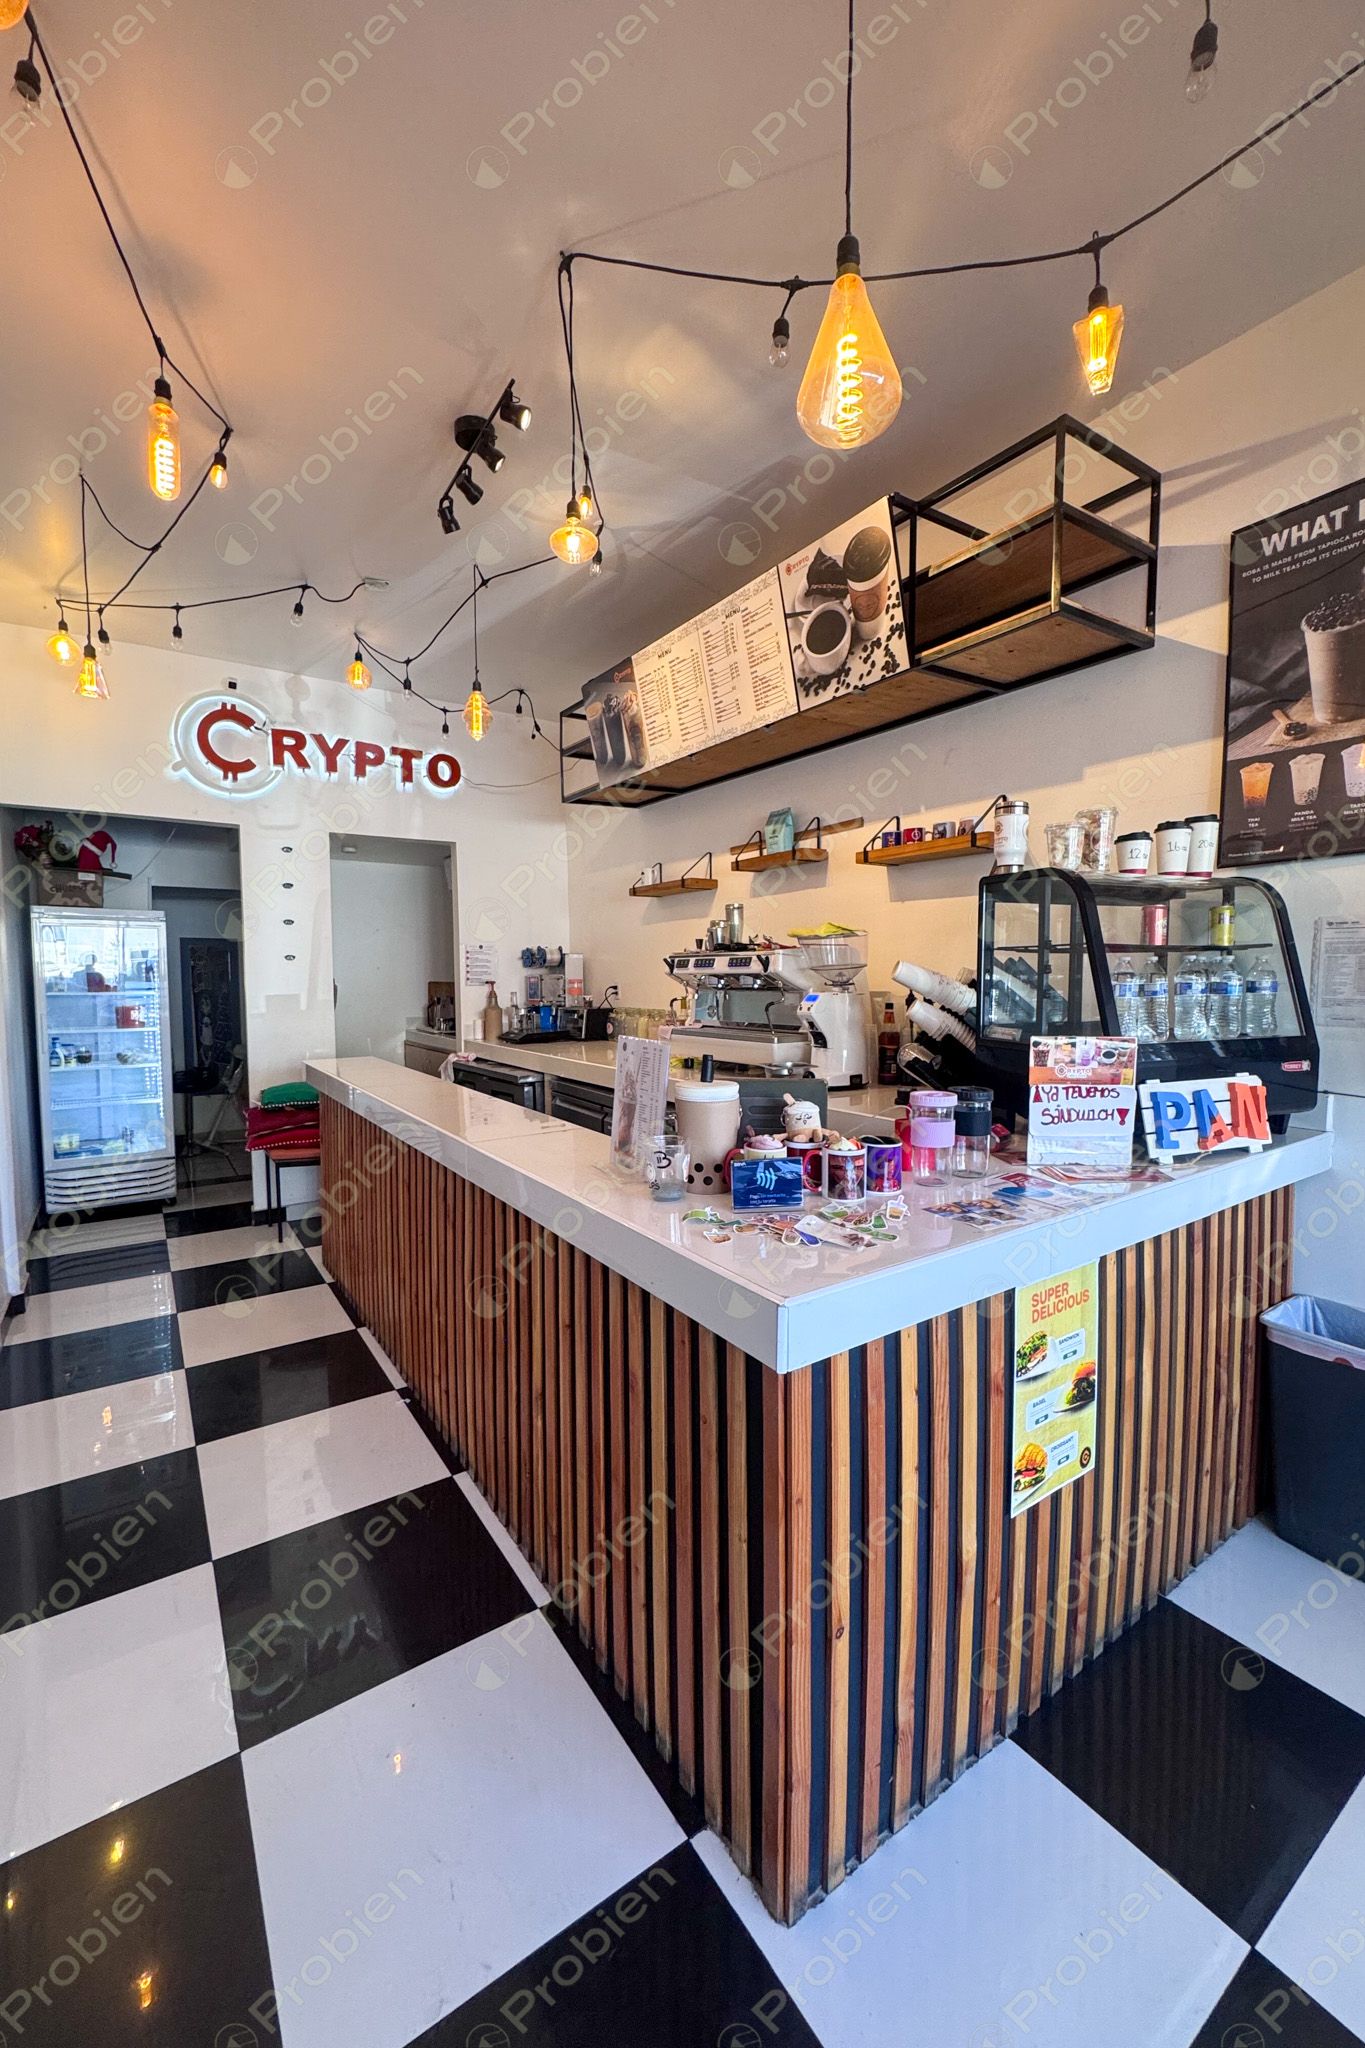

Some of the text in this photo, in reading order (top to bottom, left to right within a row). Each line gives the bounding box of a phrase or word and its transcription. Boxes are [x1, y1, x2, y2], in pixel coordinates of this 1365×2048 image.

[1260, 505, 1350, 556] WHAT
[1242, 568, 1261, 577] BOBA
[1271, 556, 1292, 566] MADE
[1294, 548, 1315, 559] FROM
[1317, 535, 1350, 550] TAPIOCA
[1264, 569, 1280, 579] MILK
[1282, 563, 1300, 573] TEAS
[1302, 557, 1317, 566] FOR
[1319, 552, 1330, 560] ITS
[1332, 540, 1360, 555] CHEWY
[725, 607, 741, 619] MENU
[197, 702, 462, 788] CRYPTO
[1128, 847, 1141, 859] 12
[1168, 841, 1180, 852] 16
[1198, 840, 1208, 849] 20
[1150, 1082, 1270, 1150] PAN
[1032, 1282, 1069, 1308] SUPER
[1032, 1289, 1090, 1324] DELICIOUS
